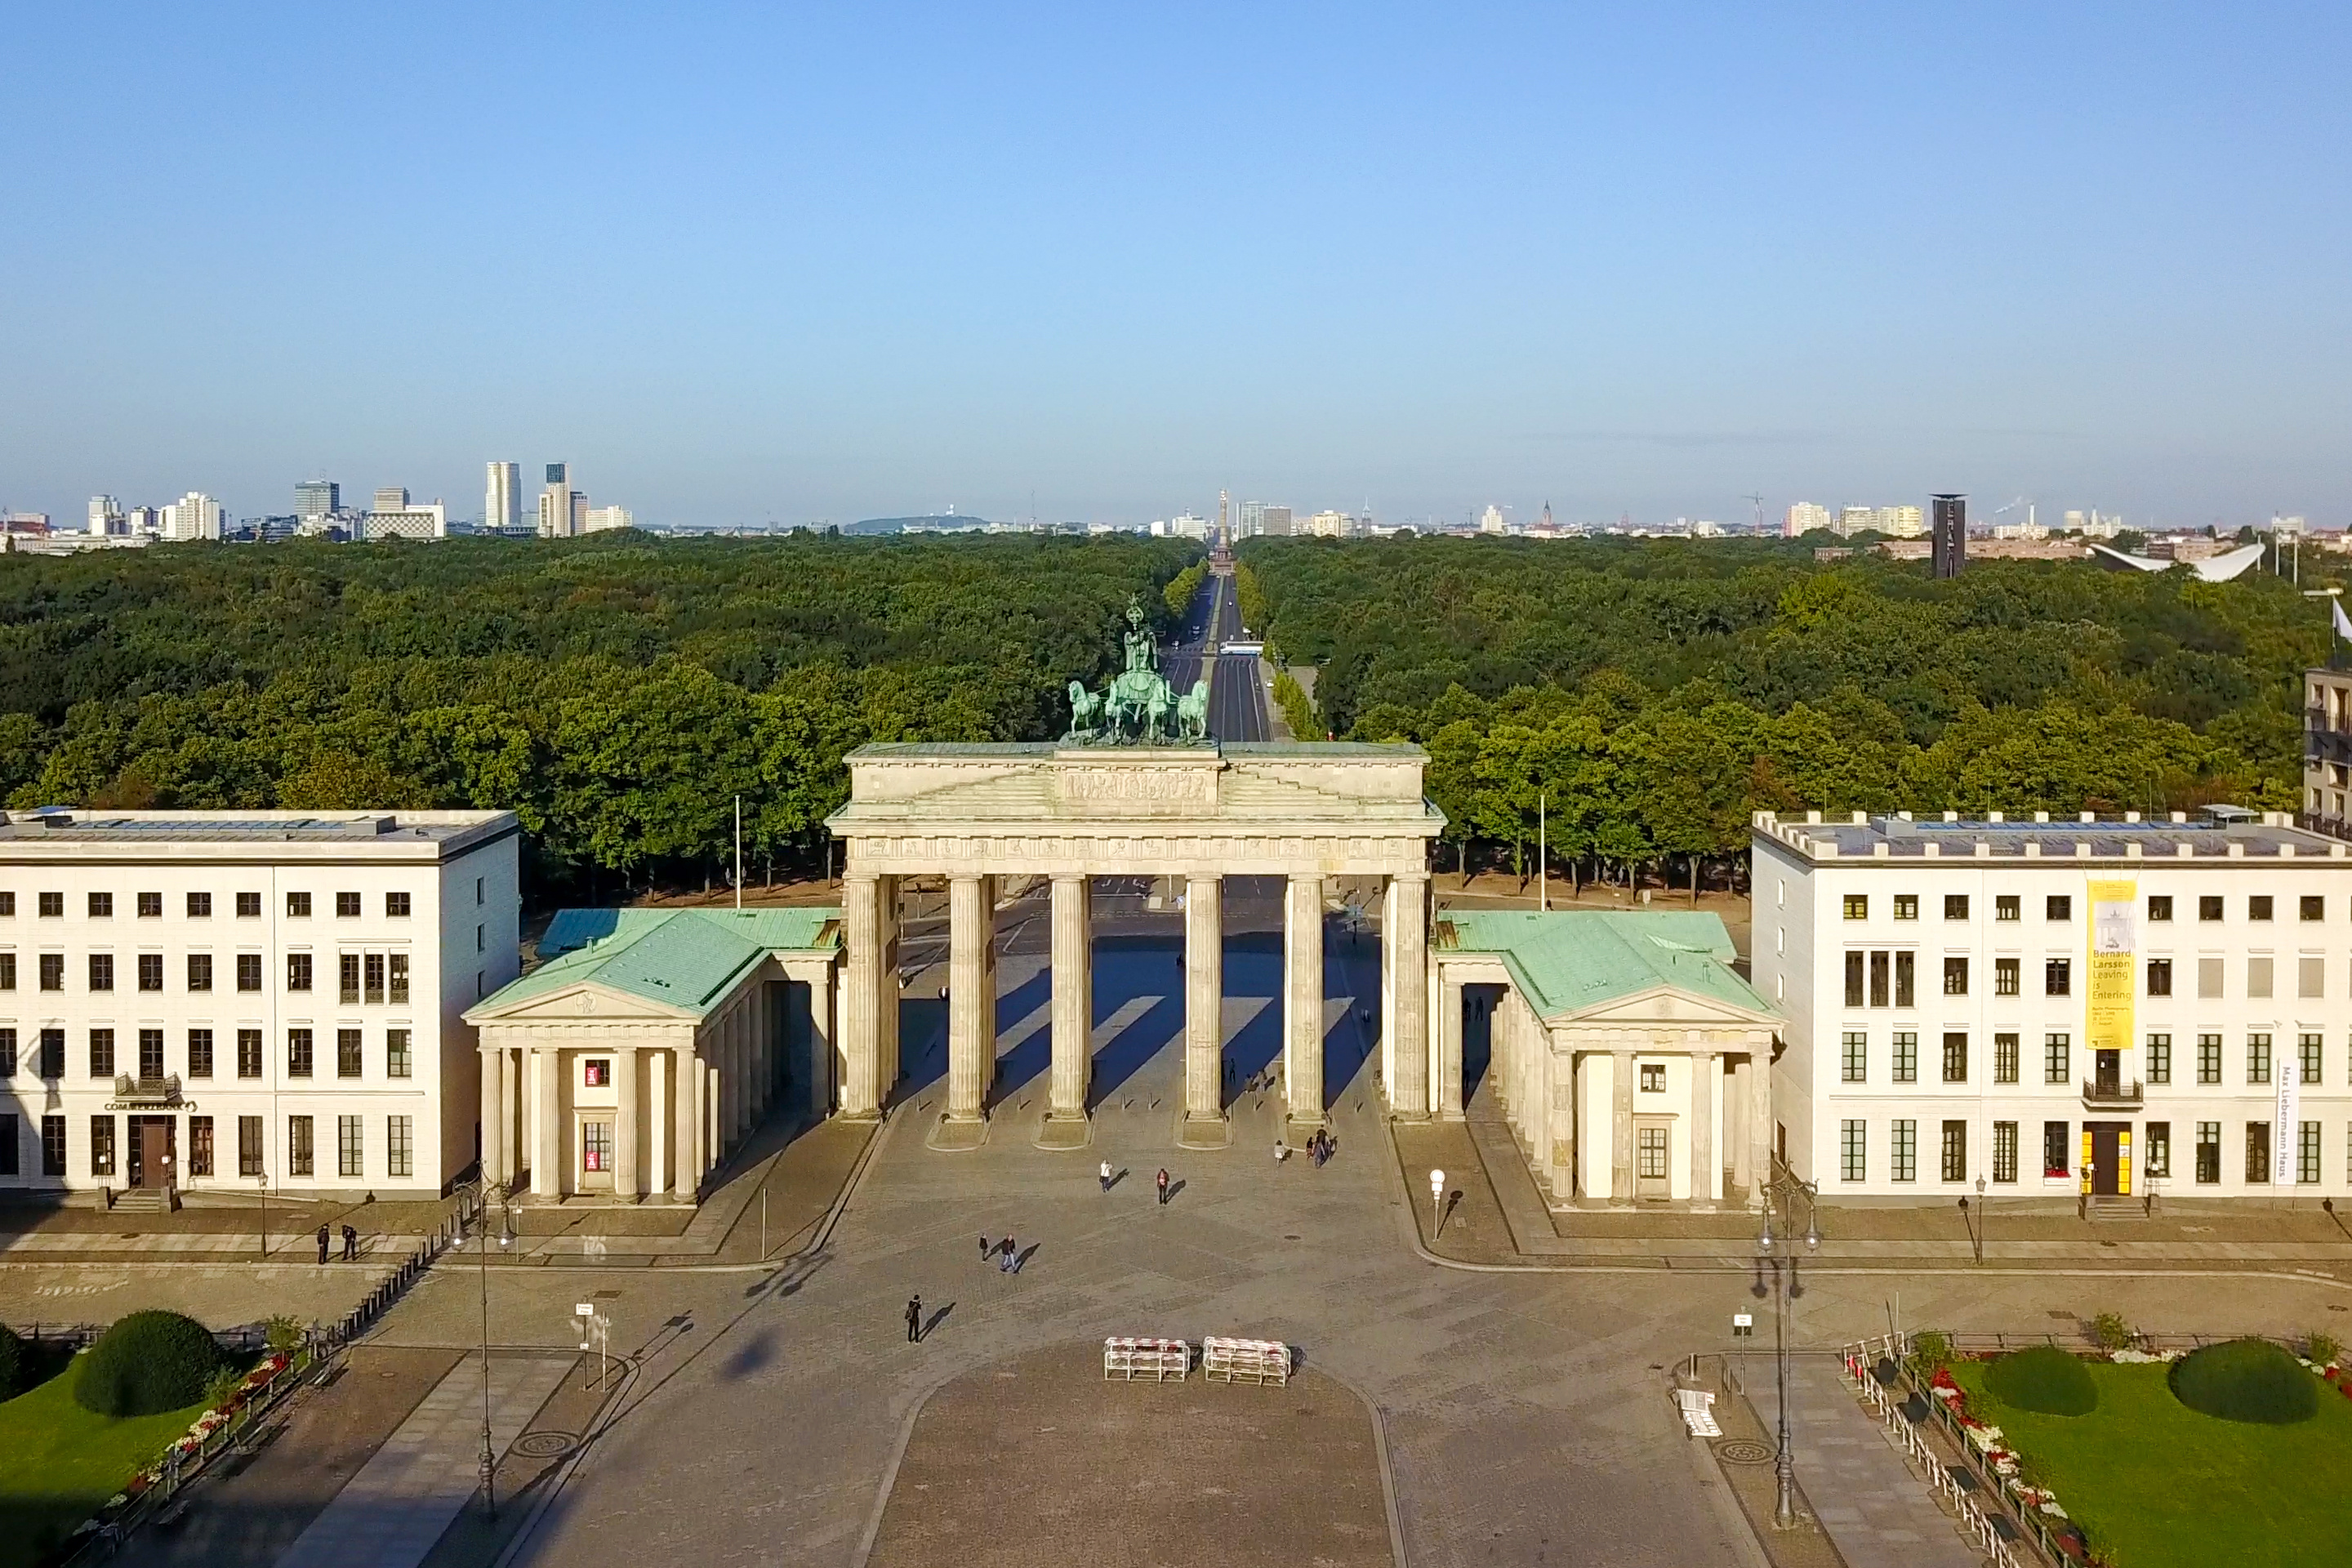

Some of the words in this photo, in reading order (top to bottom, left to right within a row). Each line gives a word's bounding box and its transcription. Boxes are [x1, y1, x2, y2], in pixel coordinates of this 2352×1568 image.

[2093, 949, 2132, 958] Bernard
[2093, 960, 2130, 969] Larsson
[2093, 970, 2128, 980] Leaving
[2092, 981, 2100, 989] is
[2092, 991, 2132, 1001] Entering
[2282, 1067, 2291, 1087] Max
[2279, 1089, 2291, 1149] Liebermann
[2278, 1152, 2288, 1177] Haus
